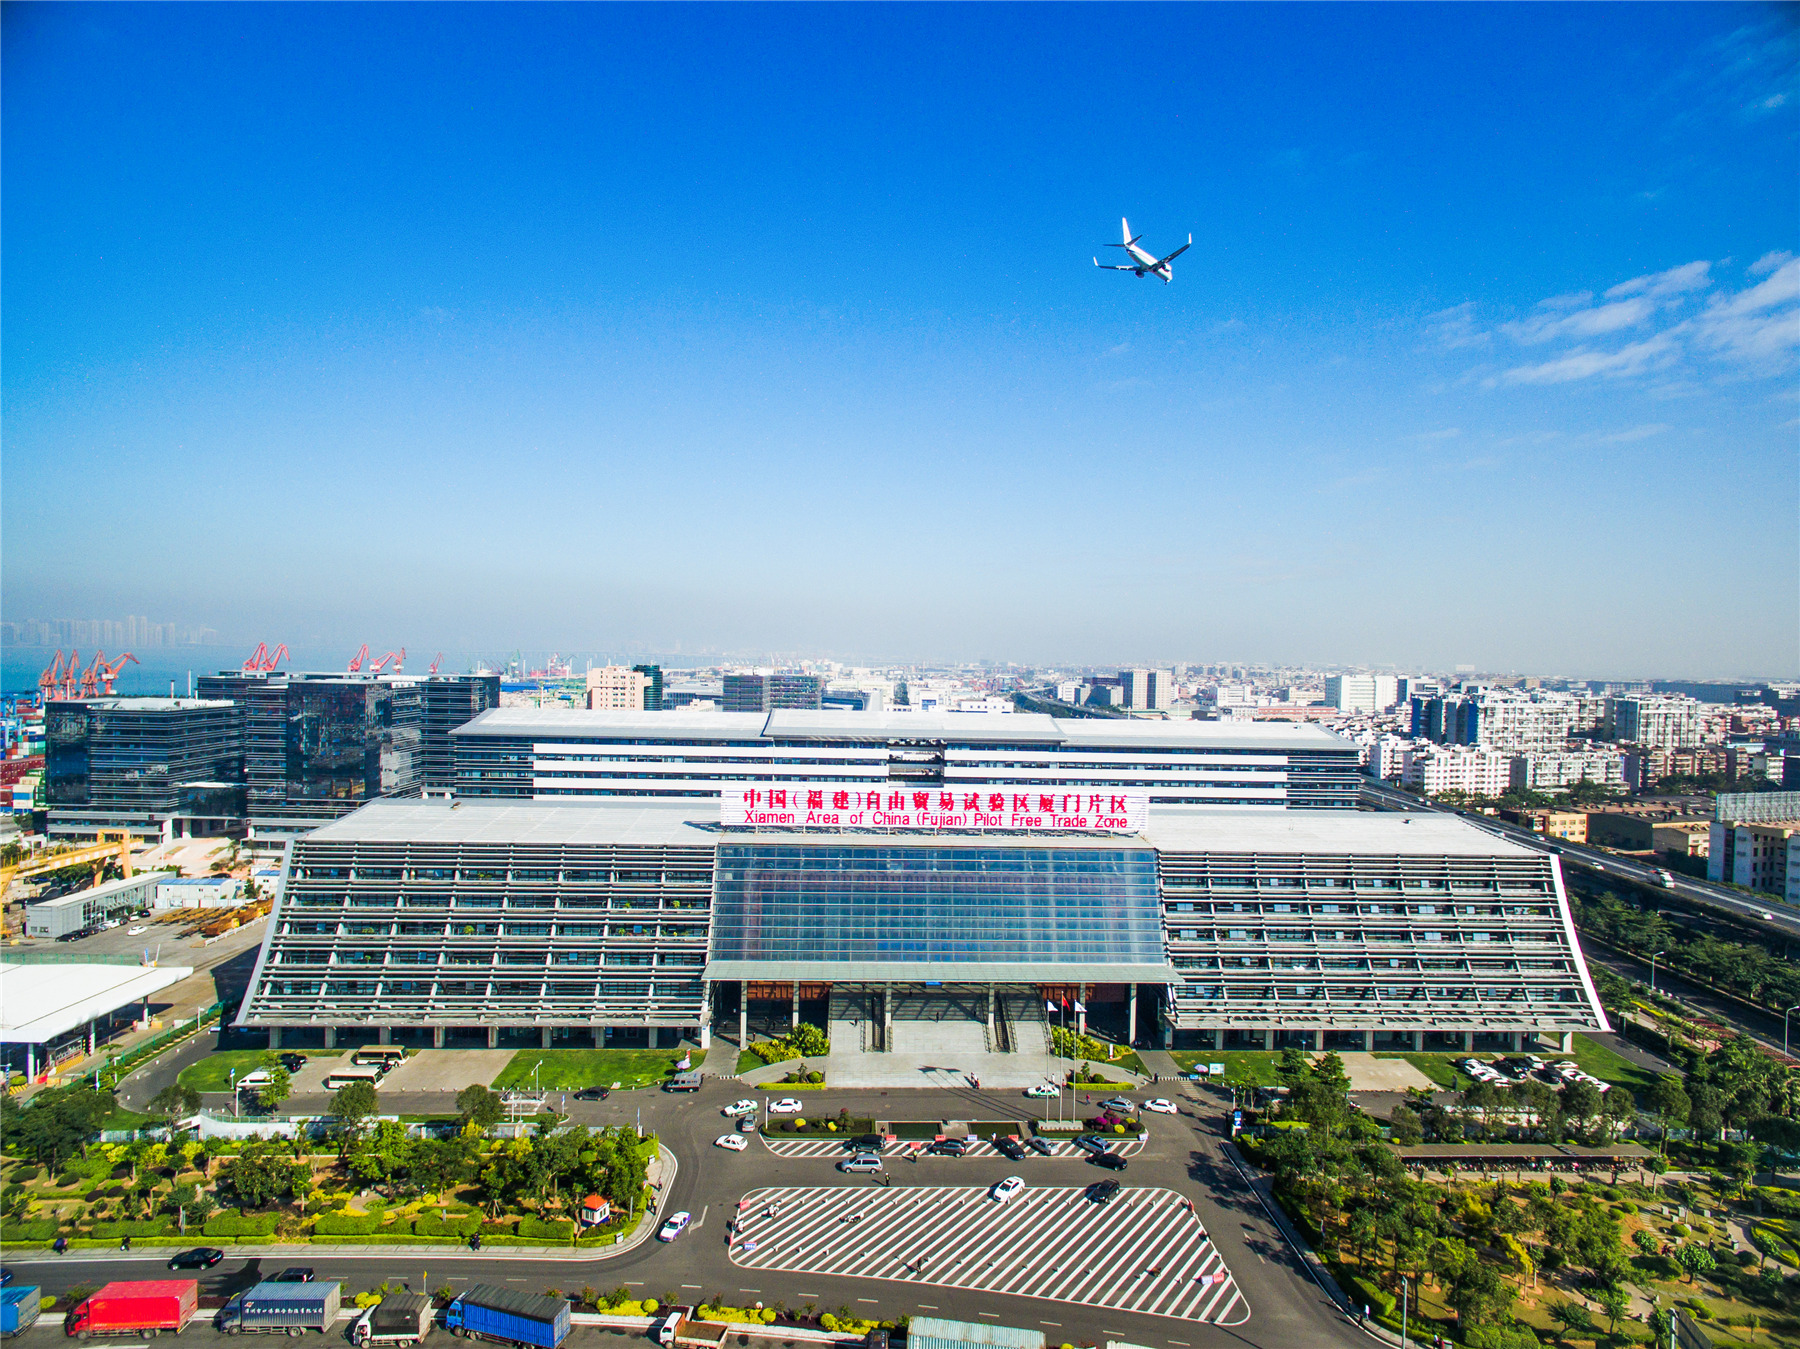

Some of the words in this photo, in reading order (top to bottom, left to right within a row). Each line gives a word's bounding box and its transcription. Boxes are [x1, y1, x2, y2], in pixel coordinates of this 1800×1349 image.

[743, 789, 1128, 814] 中国(福建)自由贸易试验区厦门片区
[744, 810, 795, 824] Xiamen
[806, 810, 839, 824] Area
[850, 811, 864, 824] of
[873, 811, 911, 825] China
[917, 811, 967, 829] (Fujian)
[974, 813, 1002, 826] Pilot
[1012, 813, 1042, 827] Free
[1050, 814, 1087, 828] Trade
[1095, 815, 1128, 828] Zone
